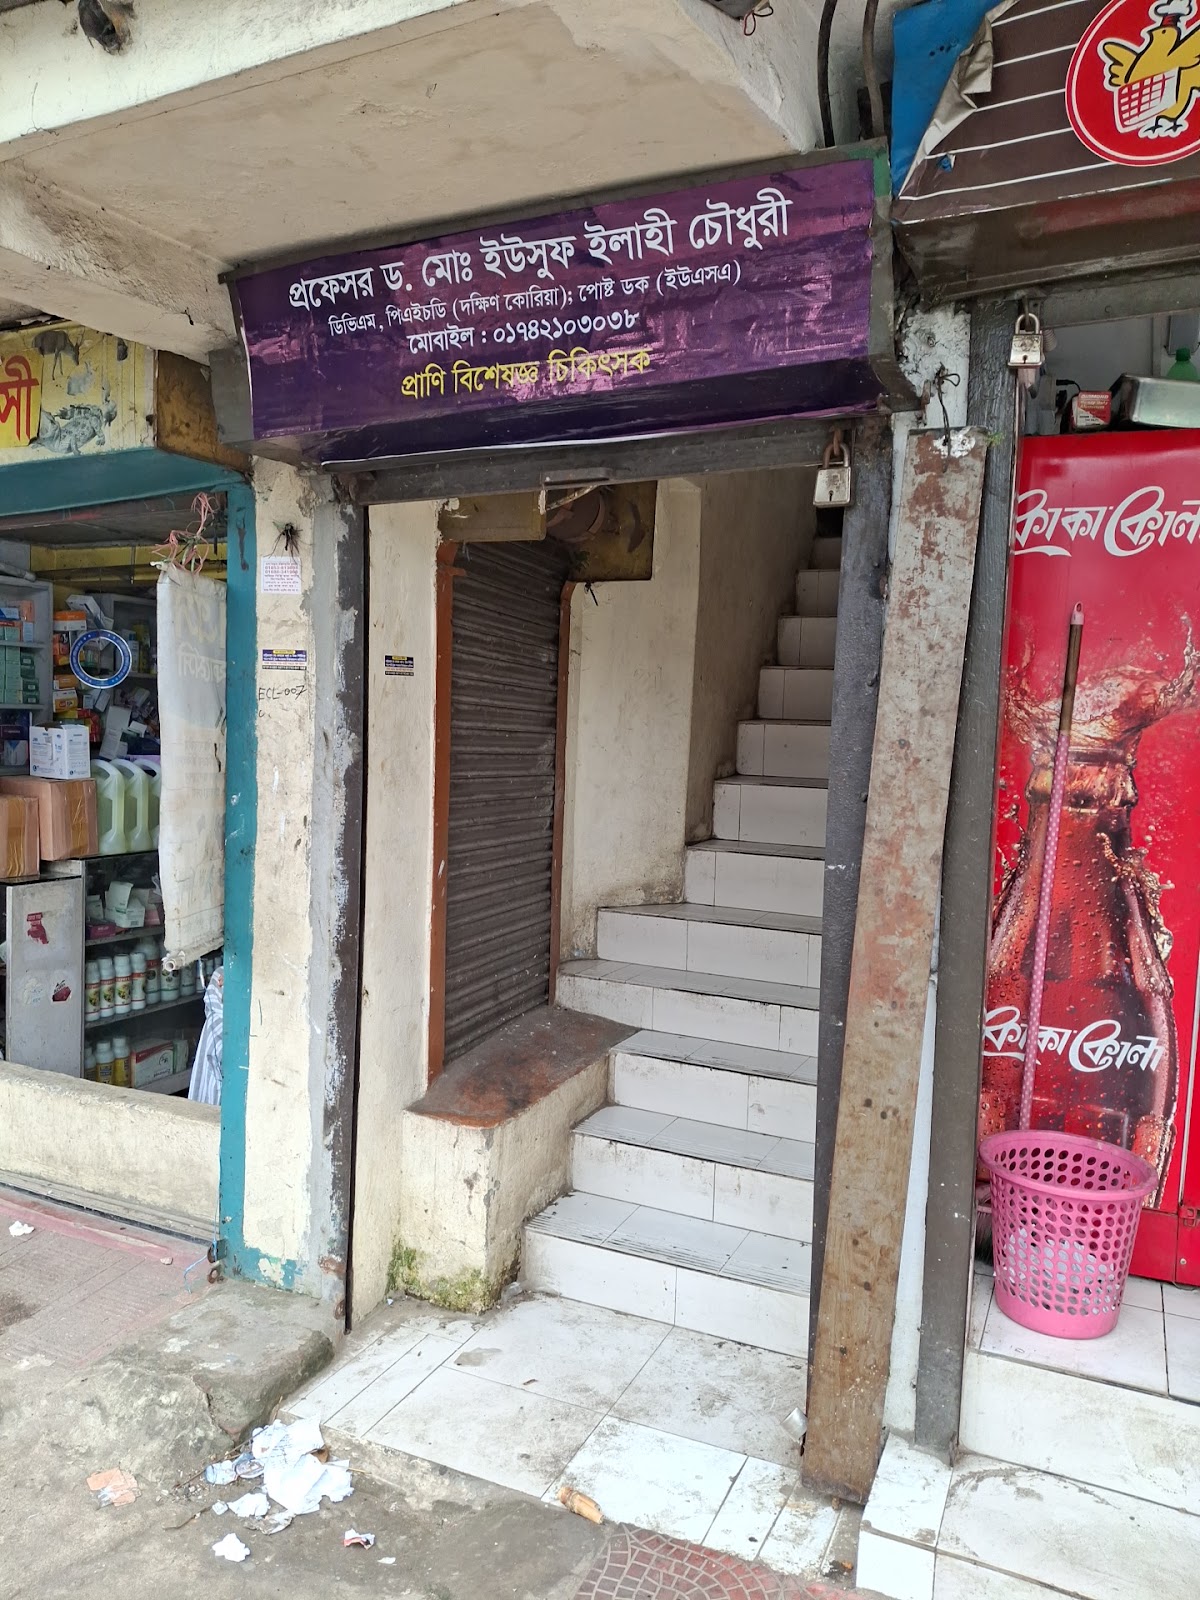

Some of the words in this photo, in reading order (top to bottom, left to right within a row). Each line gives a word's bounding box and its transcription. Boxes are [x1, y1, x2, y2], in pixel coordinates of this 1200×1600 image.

[289, 267, 374, 311] প্রফেসর
[380, 261, 413, 292] ড.
[422, 249, 473, 287] মোঃ
[479, 233, 577, 280] ইউসুফ
[584, 207, 678, 264] ইলাহী
[689, 187, 793, 250] চৌধুরী
[385, 297, 447, 326] পিএইচডি
[453, 293, 500, 321] (দক্ষিণ
[578, 277, 615, 302] পোষ্ট
[620, 275, 650, 295] ডক
[656, 259, 741, 297] (ইউএসএ)
[406, 324, 475, 354] মোবাইল
[493, 309, 640, 343] ০১৭৪২১০৩০৩৮
[401, 363, 447, 399] প্রাণি
[452, 360, 540, 394] বিশেষজ্ঞ
[548, 347, 653, 384] চিকিৎসক
